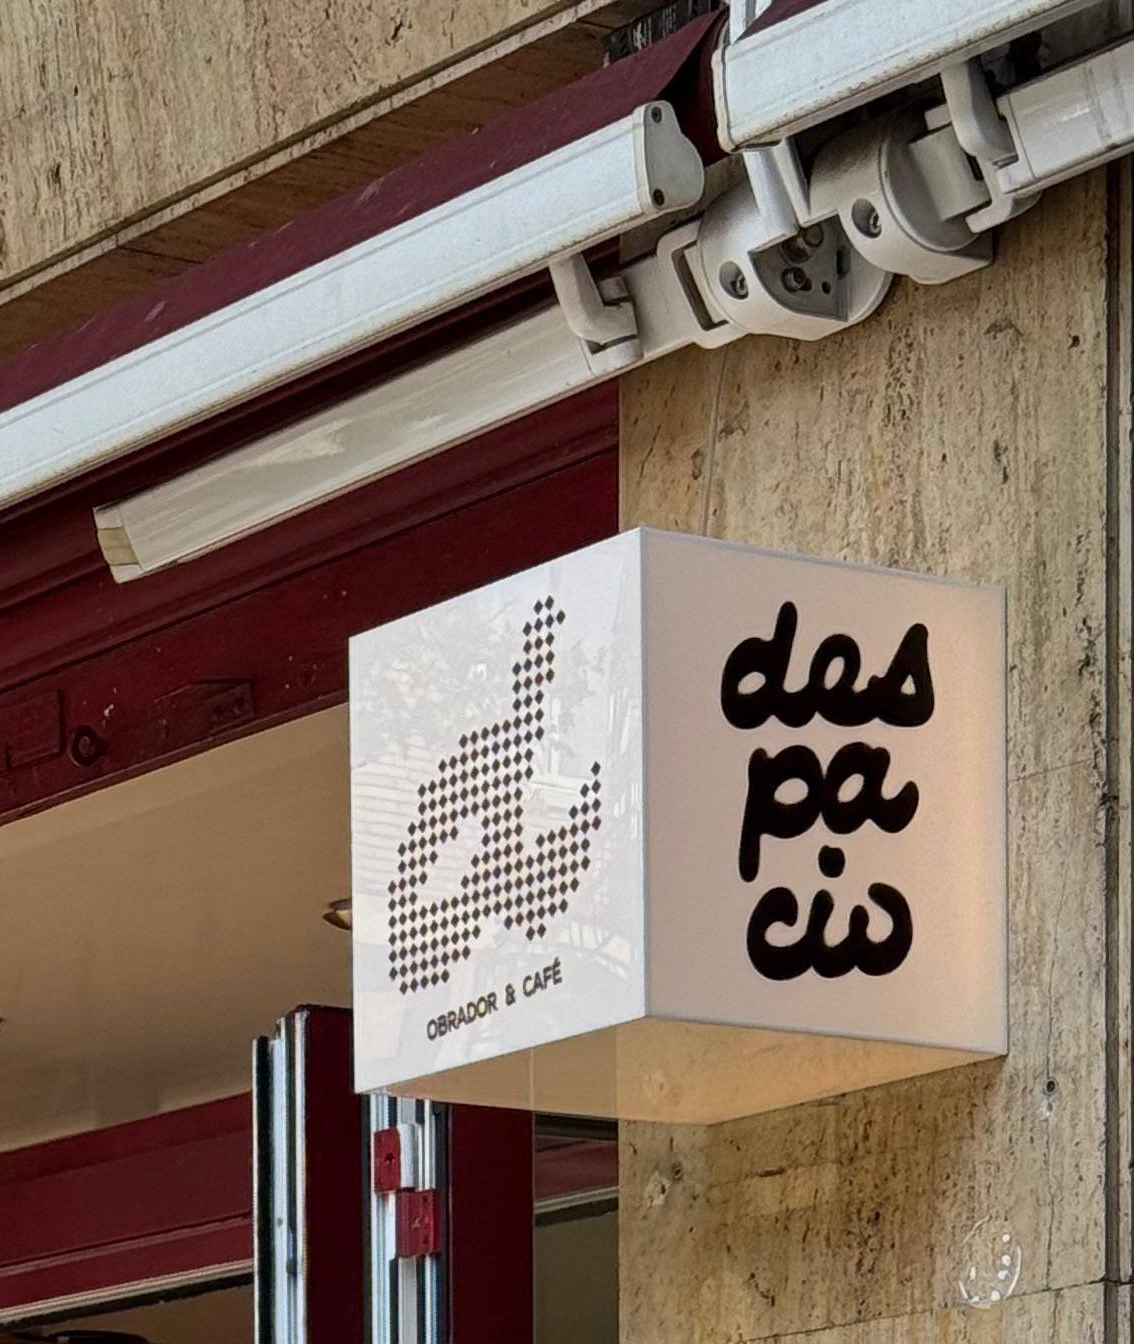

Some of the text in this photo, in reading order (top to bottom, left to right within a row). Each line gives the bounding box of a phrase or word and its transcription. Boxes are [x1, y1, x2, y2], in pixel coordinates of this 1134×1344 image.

[721, 601, 935, 729] des
[739, 741, 919, 882] pa
[747, 845, 914, 981] cio
[426, 956, 563, 1041] OBRADOR & CAFÉ
